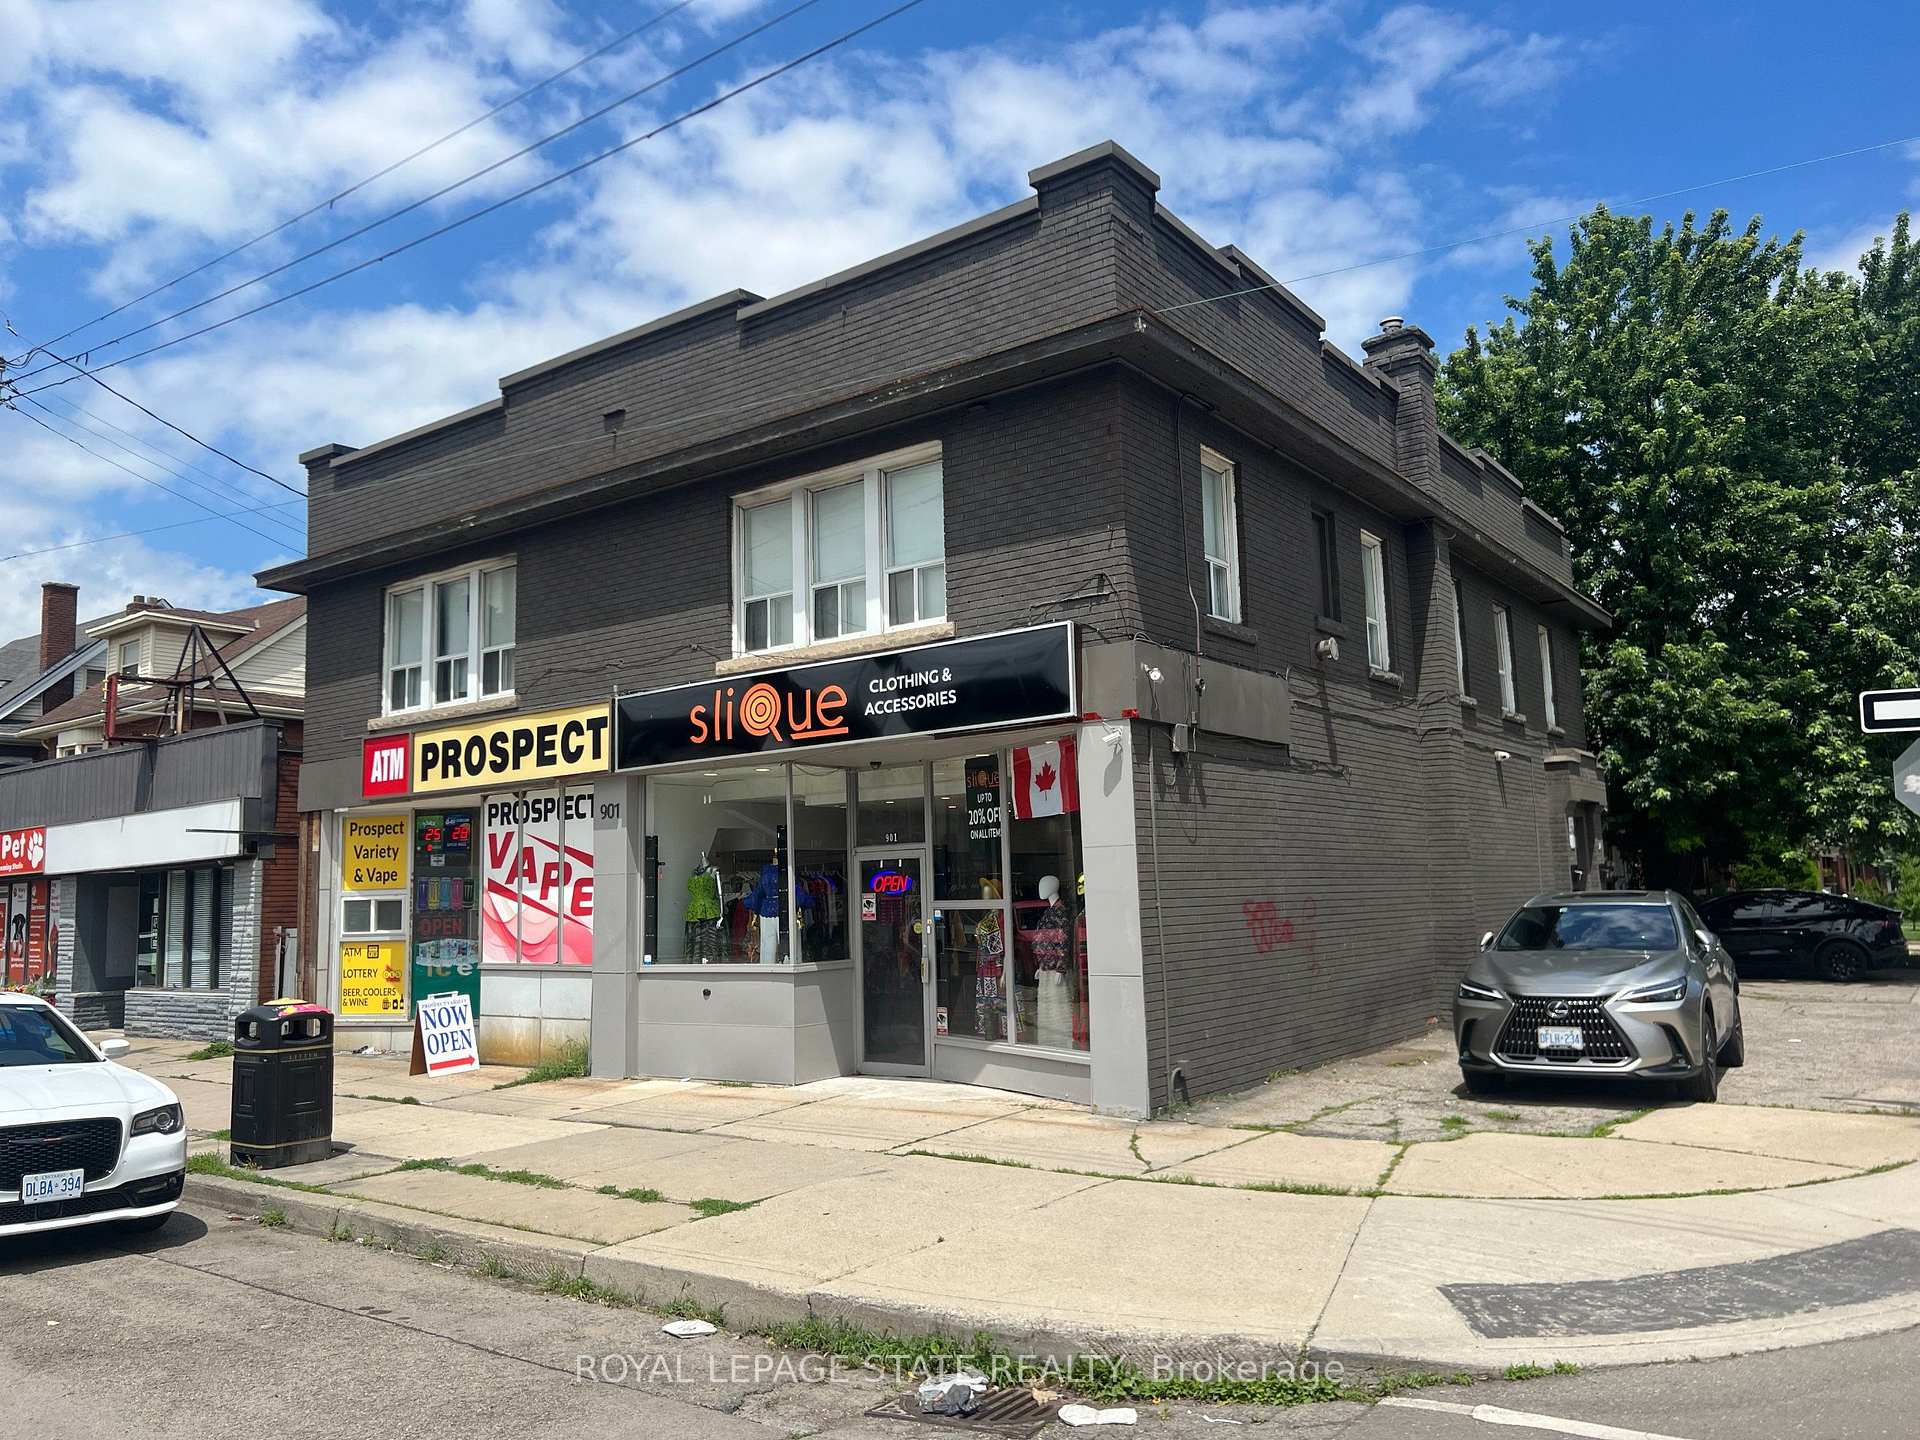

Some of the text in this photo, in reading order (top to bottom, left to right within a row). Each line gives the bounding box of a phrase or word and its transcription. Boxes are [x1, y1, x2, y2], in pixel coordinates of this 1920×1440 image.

[869, 667, 953, 693] CLOTHING &
[864, 689, 957, 716] ACCESSORIES
[421, 716, 608, 782] PROSPECT
[370, 747, 403, 783] ATM
[977, 792, 993, 803] UP TO
[600, 803, 620, 820] 901
[968, 808, 986, 825] 20%
[350, 820, 405, 838] Prospect
[425, 827, 468, 841] 25 28
[885, 833, 897, 842] 901
[970, 830, 979, 840] ON
[979, 829, 988, 839] ALL
[1, 832, 26, 860] Pet
[353, 844, 399, 861] Variety
[354, 867, 398, 885] & Vape
[488, 831, 594, 916] VAPE
[873, 875, 909, 893] OPEN
[421, 917, 463, 936] OPEN
[344, 947, 362, 957] ATM
[343, 968, 378, 979] LOTTERY
[363, 987, 397, 997] COOLERS
[342, 998, 369, 1006] & WINE
[422, 1005, 468, 1030] NOW
[427, 1029, 472, 1055] OPEN
